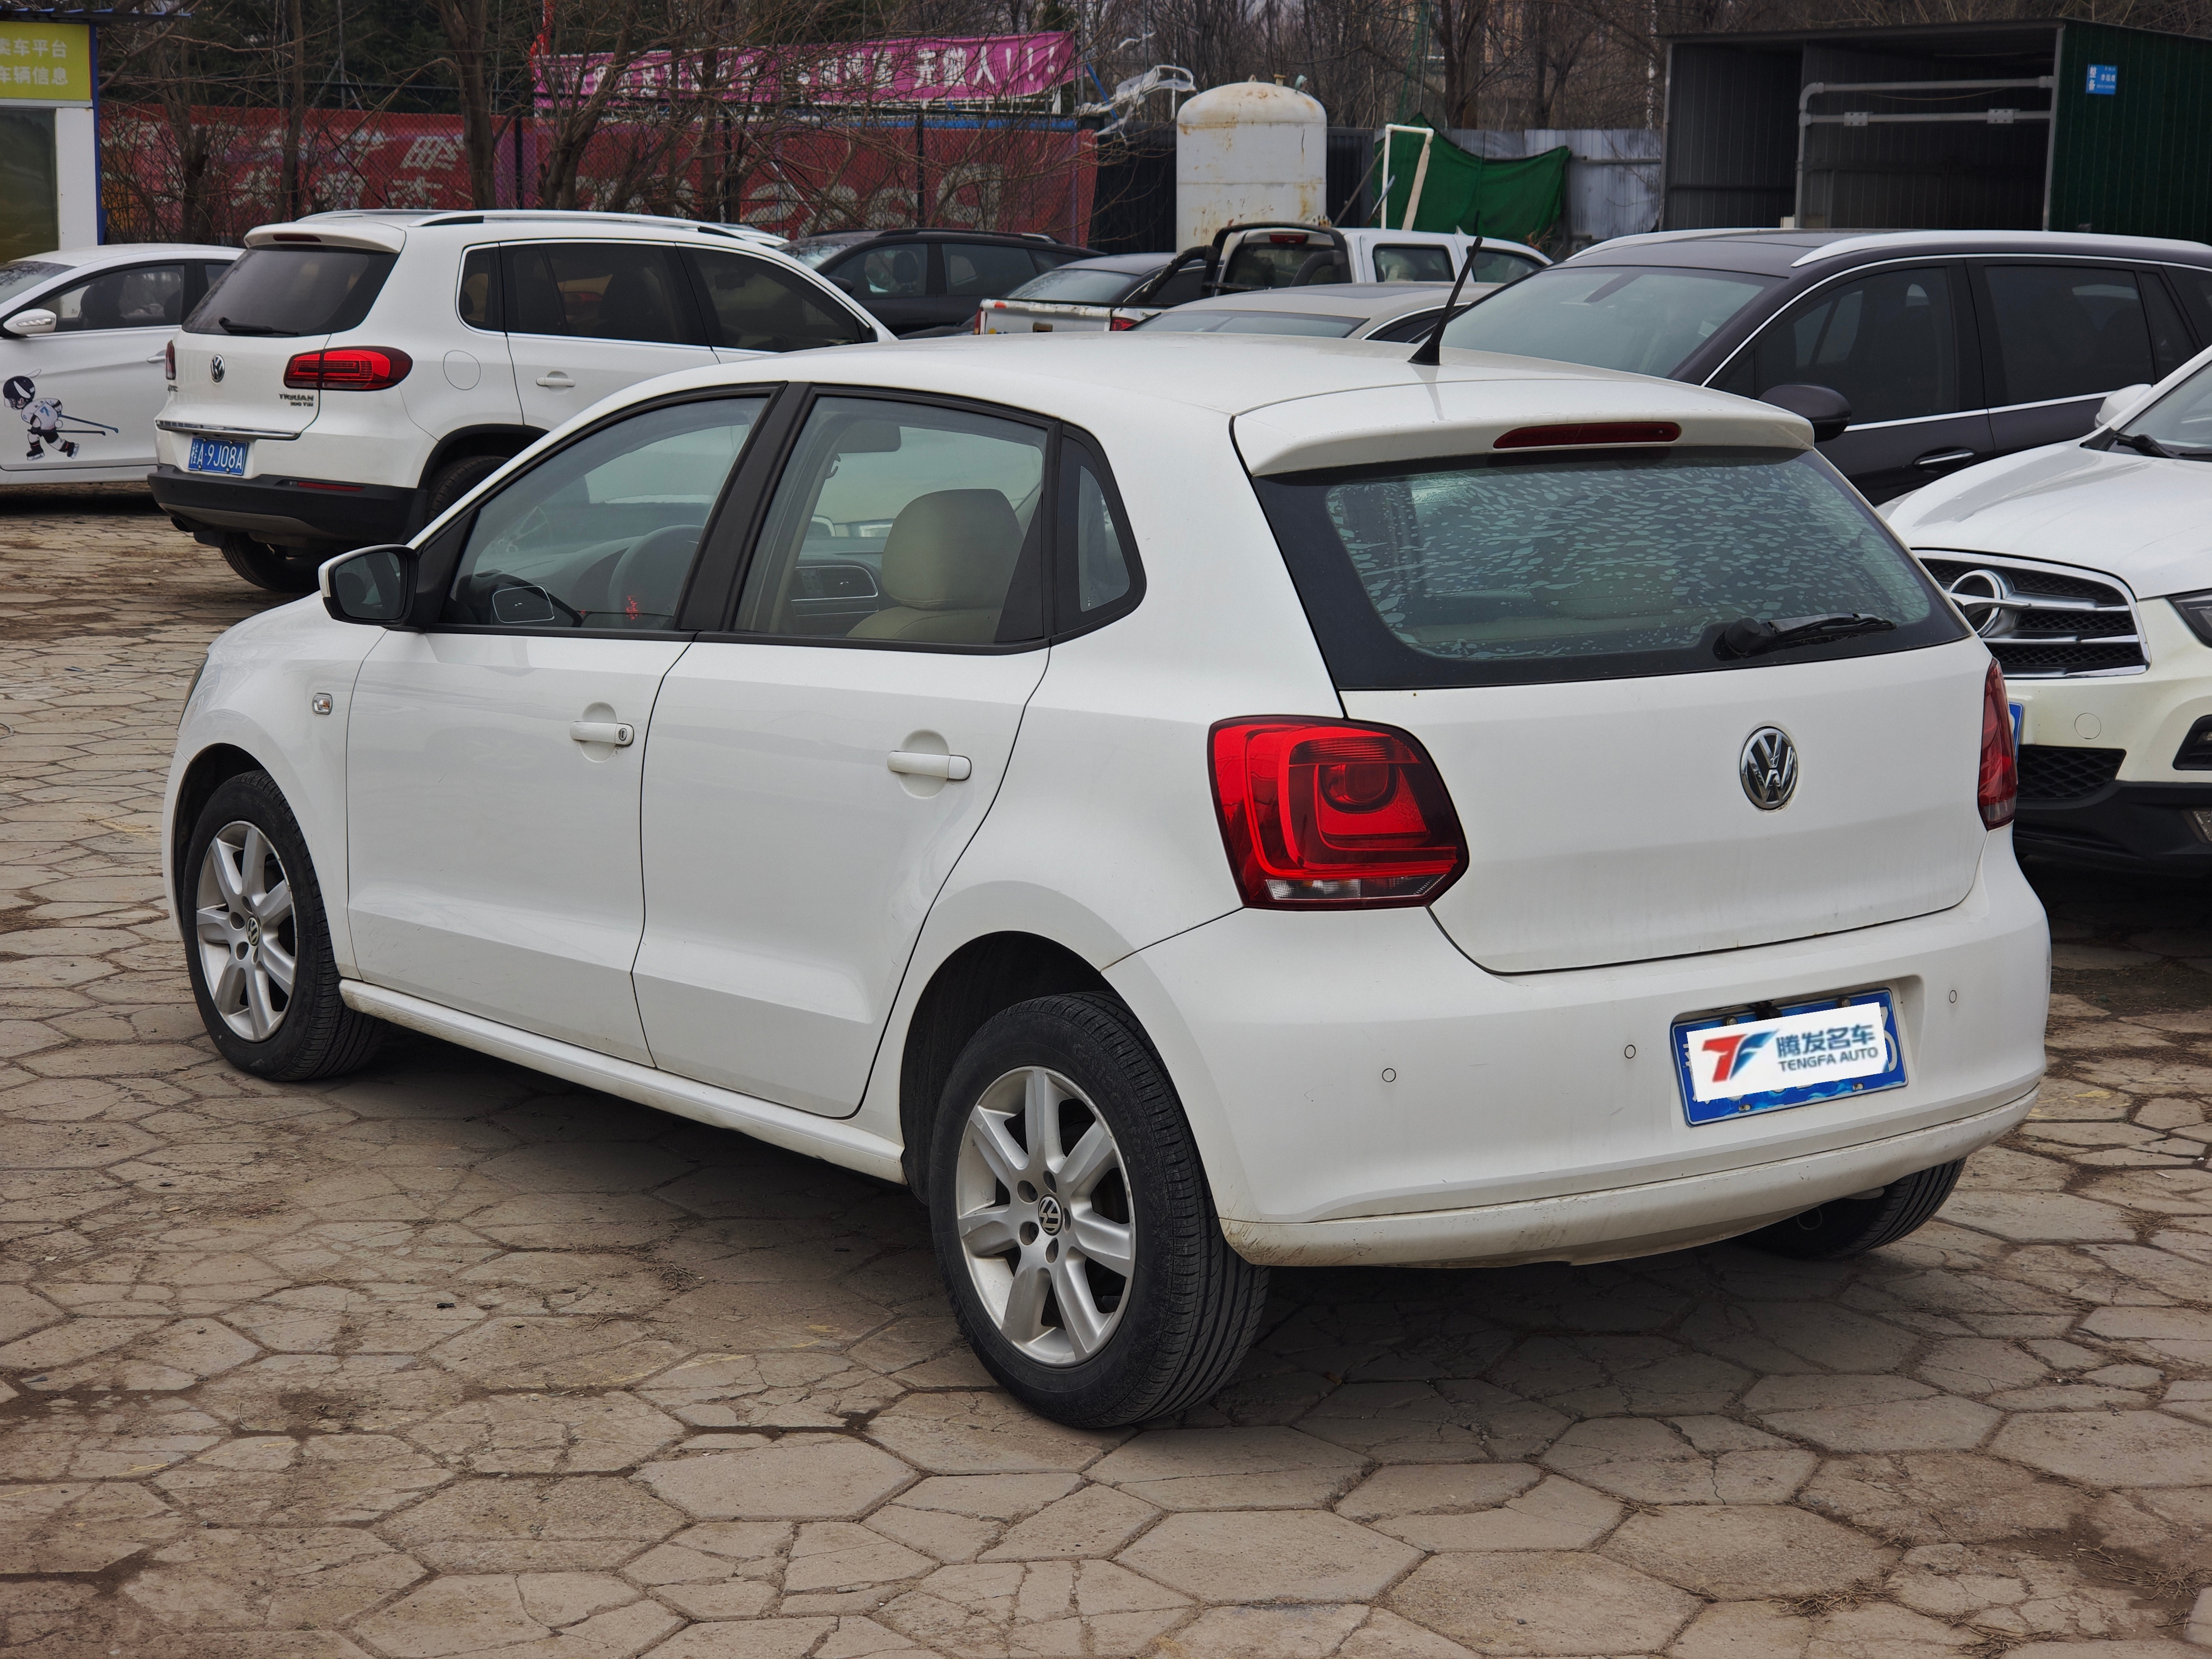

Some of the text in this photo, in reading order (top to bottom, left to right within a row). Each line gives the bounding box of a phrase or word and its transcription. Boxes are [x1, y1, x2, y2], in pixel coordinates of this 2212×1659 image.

[0, 66, 68, 85] 车辆信息
[279, 393, 314, 401] TIGUAN
